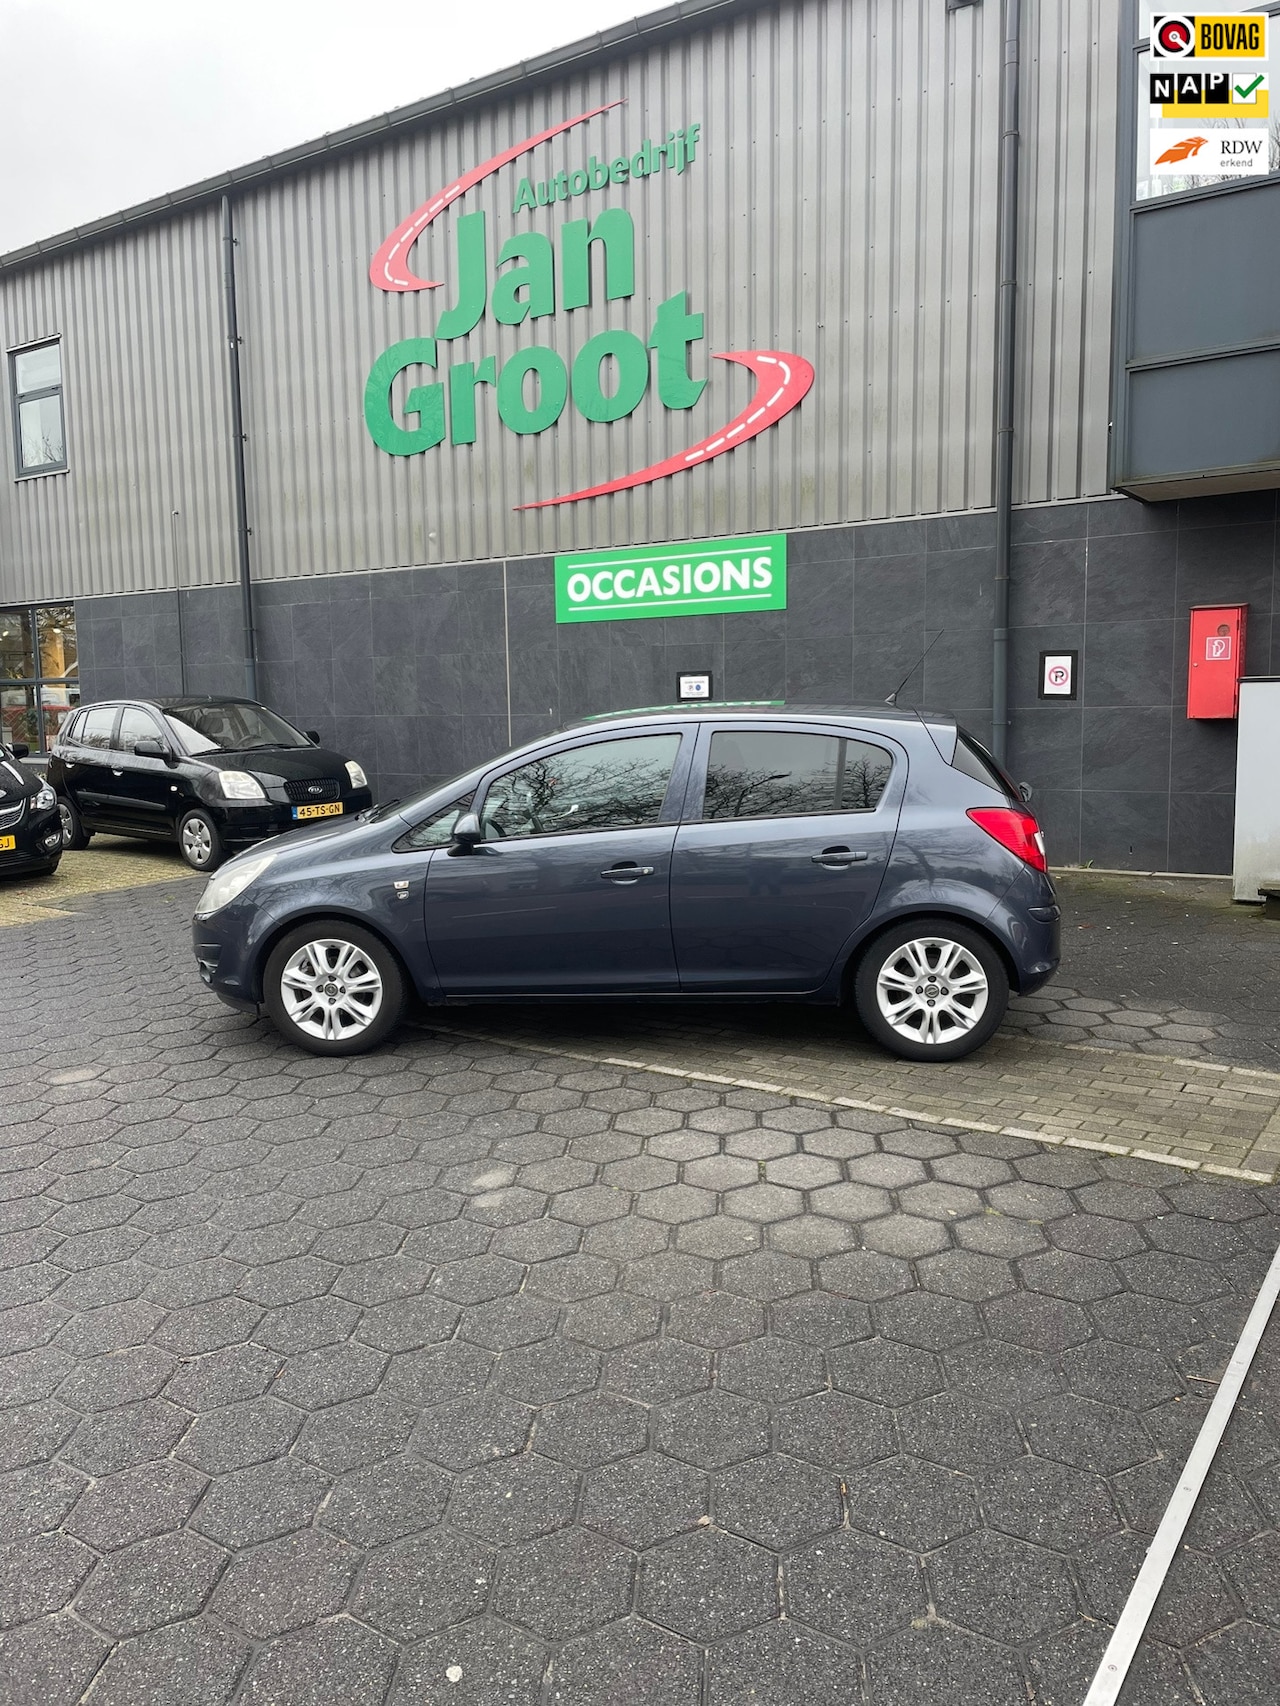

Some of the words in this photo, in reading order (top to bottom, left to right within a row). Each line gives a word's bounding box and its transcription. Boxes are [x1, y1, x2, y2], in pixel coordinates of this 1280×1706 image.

[512, 123, 700, 213] Autobedrijf
[435, 208, 635, 340] Jan
[364, 290, 708, 456] Groot
[567, 556, 773, 603] OCCASIONS
[299, 804, 340, 817] 45-TS-GN
